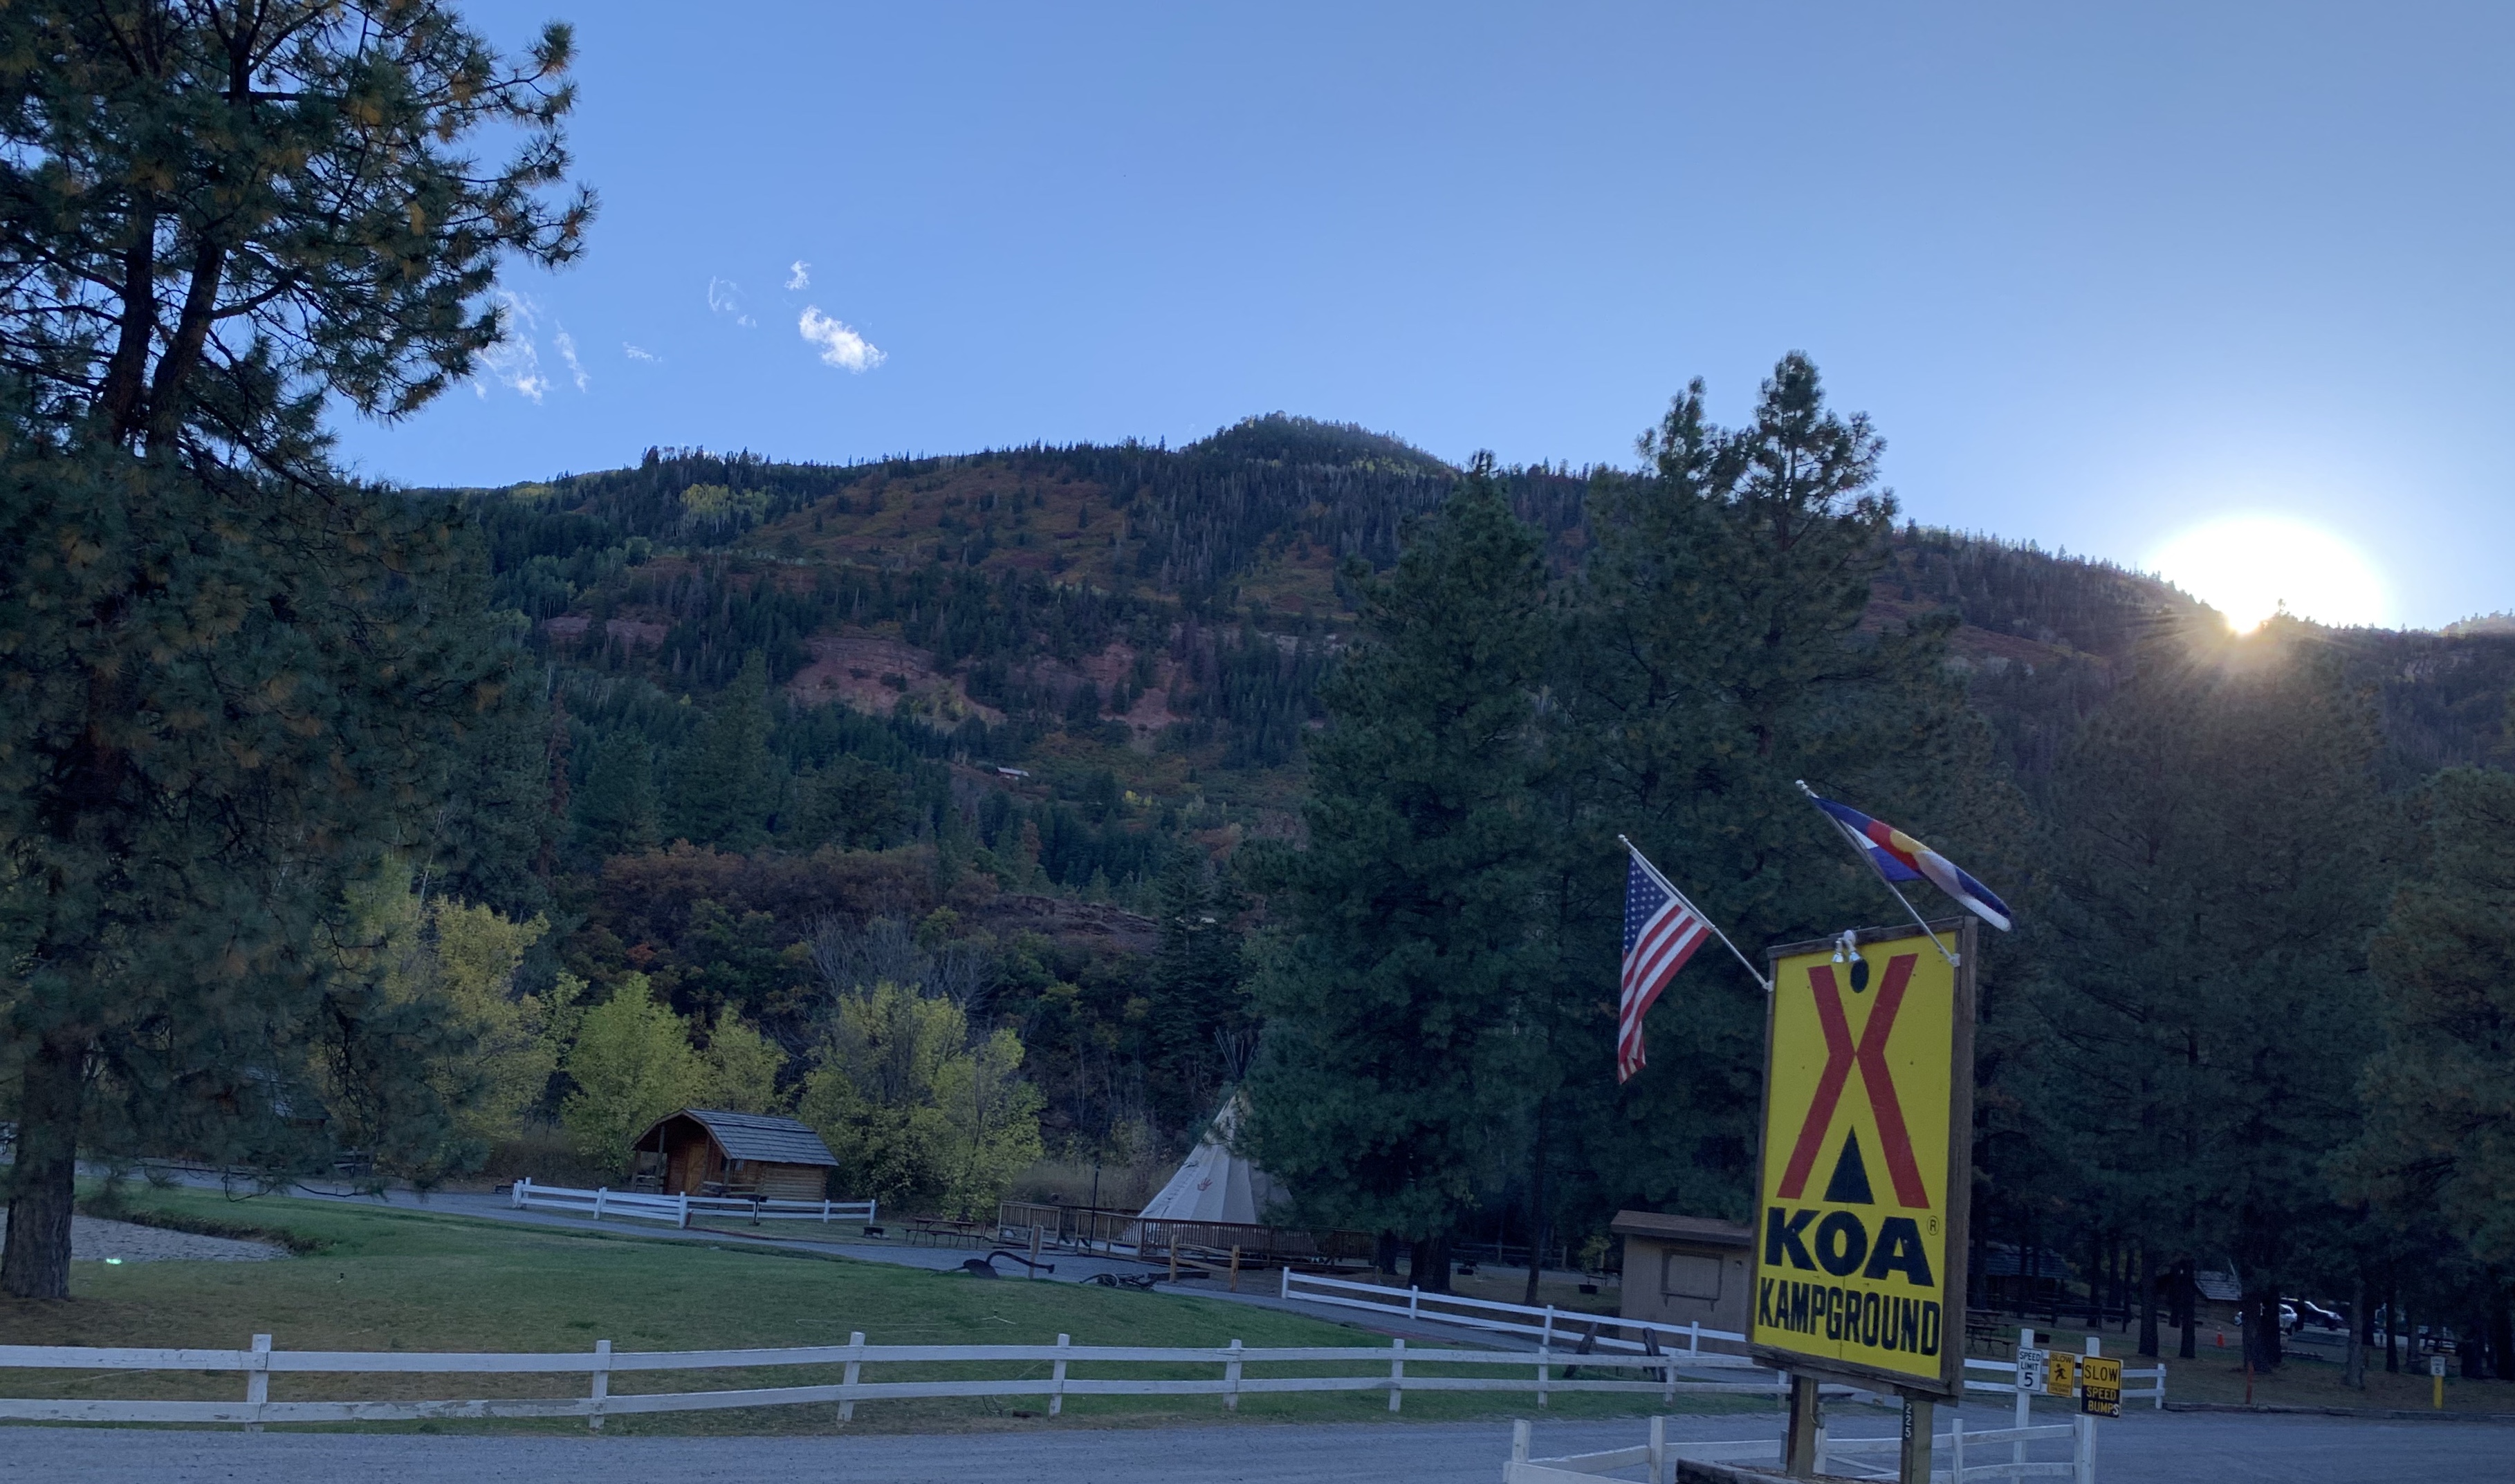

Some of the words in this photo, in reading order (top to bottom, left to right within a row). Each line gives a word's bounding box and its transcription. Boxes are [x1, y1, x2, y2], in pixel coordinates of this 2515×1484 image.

[1765, 1207, 1935, 1287] KOA
[1758, 1277, 1940, 1356] KAMPGROUND
[2019, 1351, 2040, 1362] SPEED
[2051, 1353, 2072, 1364] SLOW
[2020, 1362, 2039, 1371] LIMIT
[2084, 1364, 2118, 1382] SLOW
[2025, 1372, 2034, 1387] 5
[2086, 1386, 2117, 1401] SPEED
[2088, 1400, 2119, 1416] BUMPS
